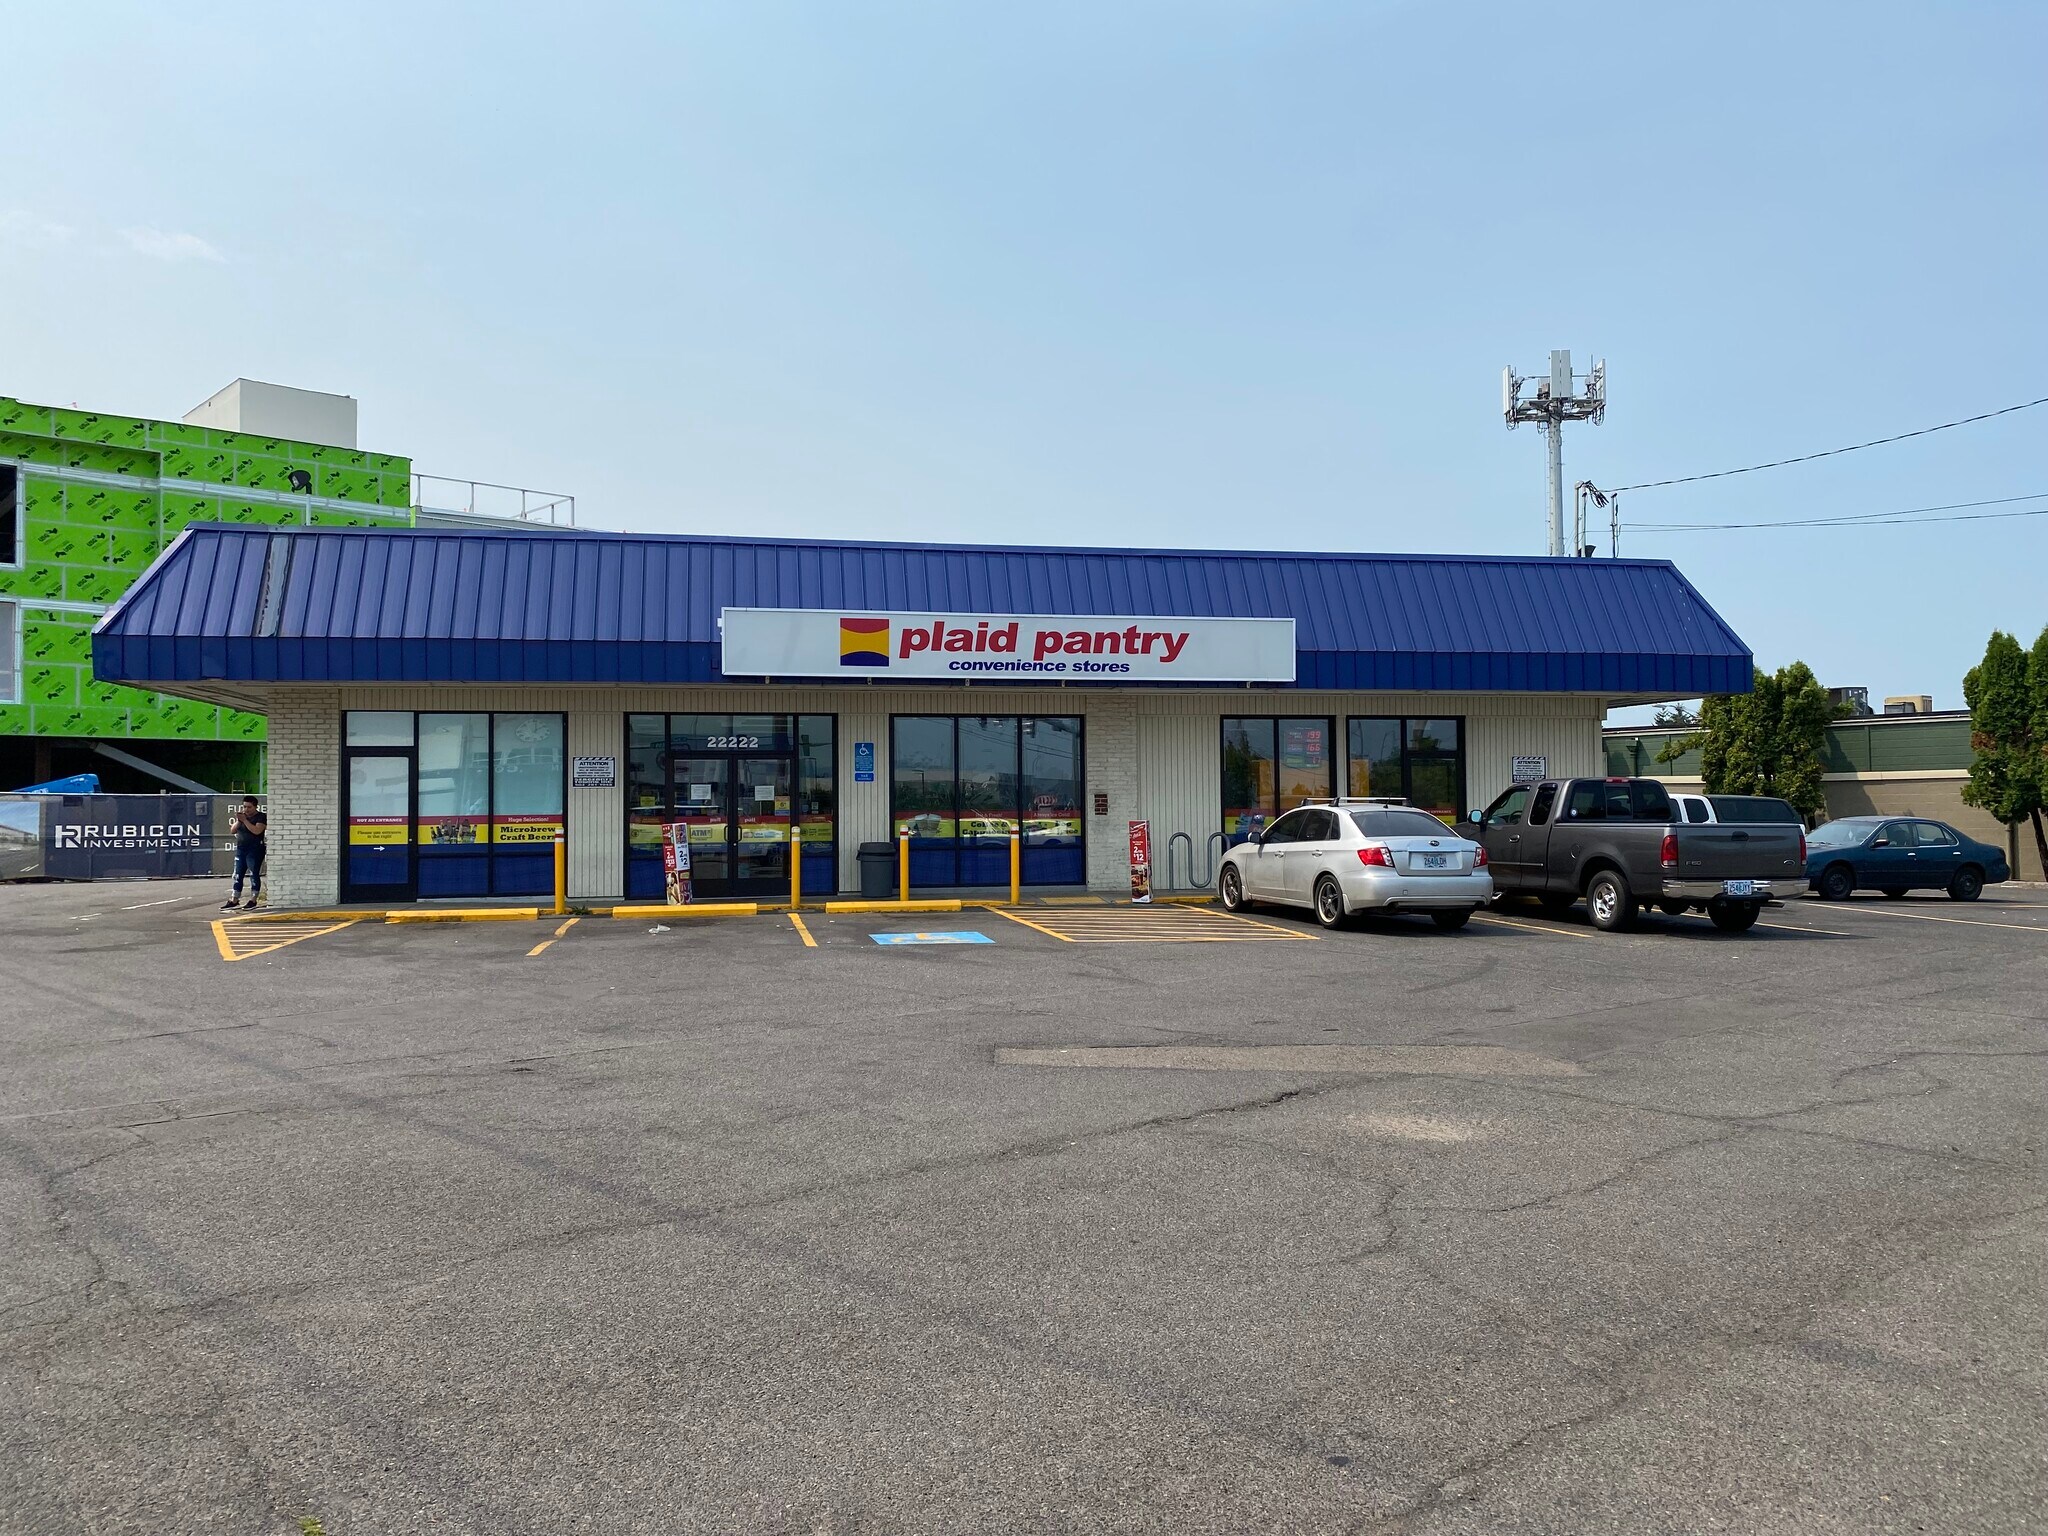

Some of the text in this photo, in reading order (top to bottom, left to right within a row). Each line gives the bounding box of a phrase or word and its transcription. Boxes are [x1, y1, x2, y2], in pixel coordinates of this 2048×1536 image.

[899, 621, 1189, 663] plaid pantry
[948, 659, 1131, 674] convenience stores
[707, 736, 759, 748] 22222
[84, 824, 201, 837] RUBICON
[83, 837, 201, 849] INVESTMENTS
[501, 833, 526, 841] Craft
